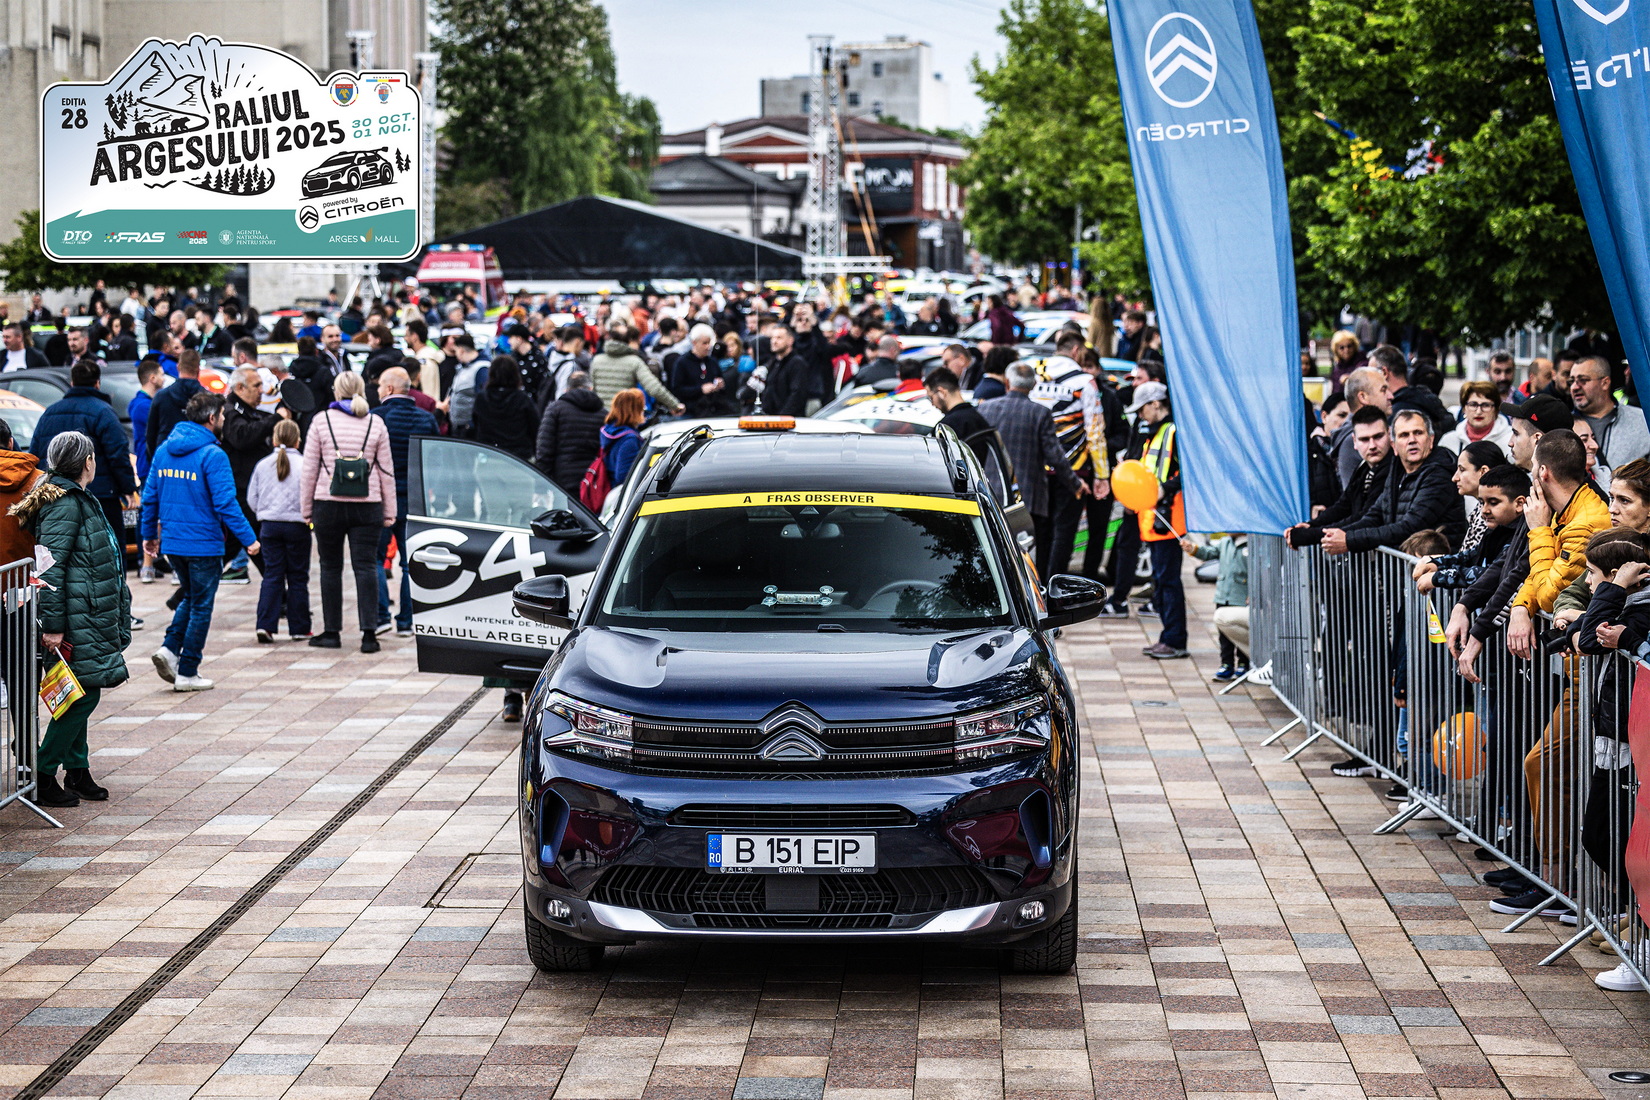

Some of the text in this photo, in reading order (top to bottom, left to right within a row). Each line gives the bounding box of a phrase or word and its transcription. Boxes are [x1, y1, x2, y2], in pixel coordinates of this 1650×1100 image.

[742, 494, 875, 504] A FRAS OBSERVER
[406, 528, 547, 605] C4
[464, 616, 515, 626] PARTENER
[415, 624, 479, 639] RALIUL
[735, 837, 861, 865] B 151 EIP
[709, 852, 721, 864] RO
[778, 866, 805, 874] EURIAL
